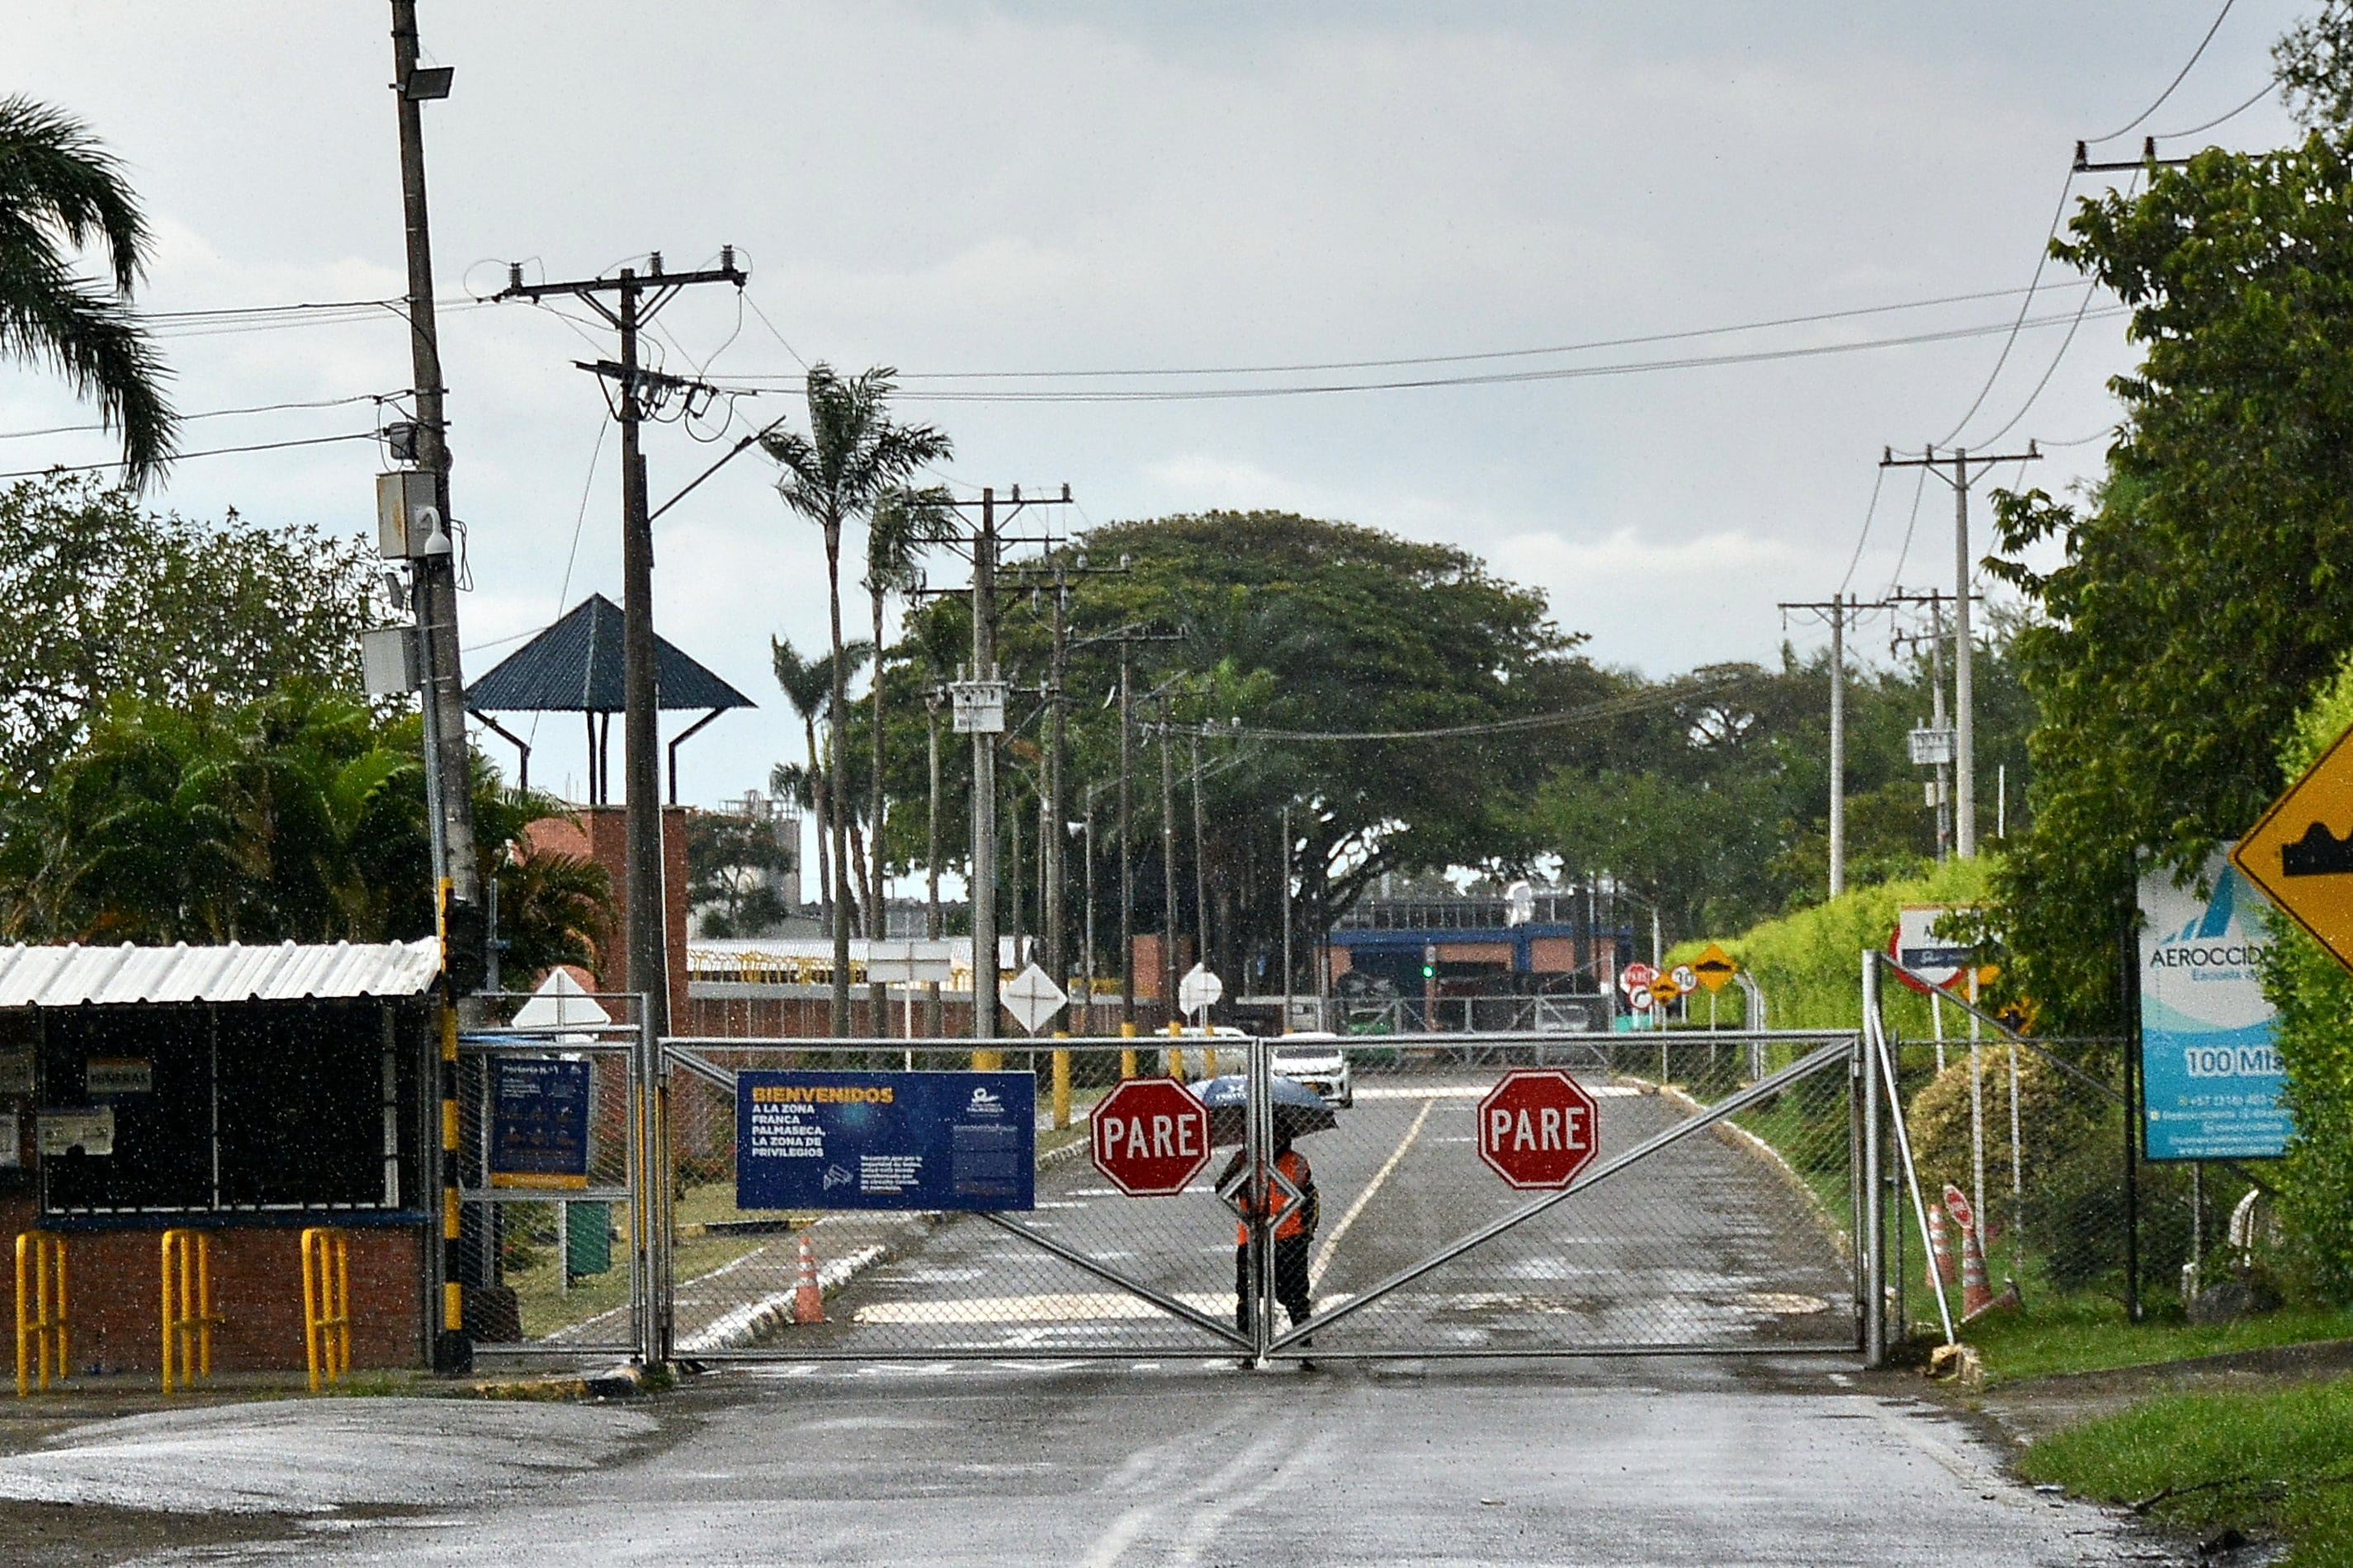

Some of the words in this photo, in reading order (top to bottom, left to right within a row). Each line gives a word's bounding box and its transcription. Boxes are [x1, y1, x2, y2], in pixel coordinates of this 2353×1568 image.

[2149, 947, 2264, 967] AEROCCID
[2187, 1048, 2232, 1074] 100
[752, 1086, 894, 1103] BIENVENIDOS
[752, 1103, 761, 1113] A
[763, 1103, 779, 1113] LA
[781, 1103, 815, 1113] ZONA
[752, 1115, 801, 1125] FRANCA
[752, 1126, 826, 1137] PALMASECA,
[1491, 1107, 1586, 1152] PARE
[752, 1136, 768, 1146] LA
[769, 1136, 804, 1146] ZONA
[805, 1136, 822, 1146] DE
[1103, 1114, 1199, 1160] PARE
[752, 1147, 824, 1157] PRIVILEGIOS
